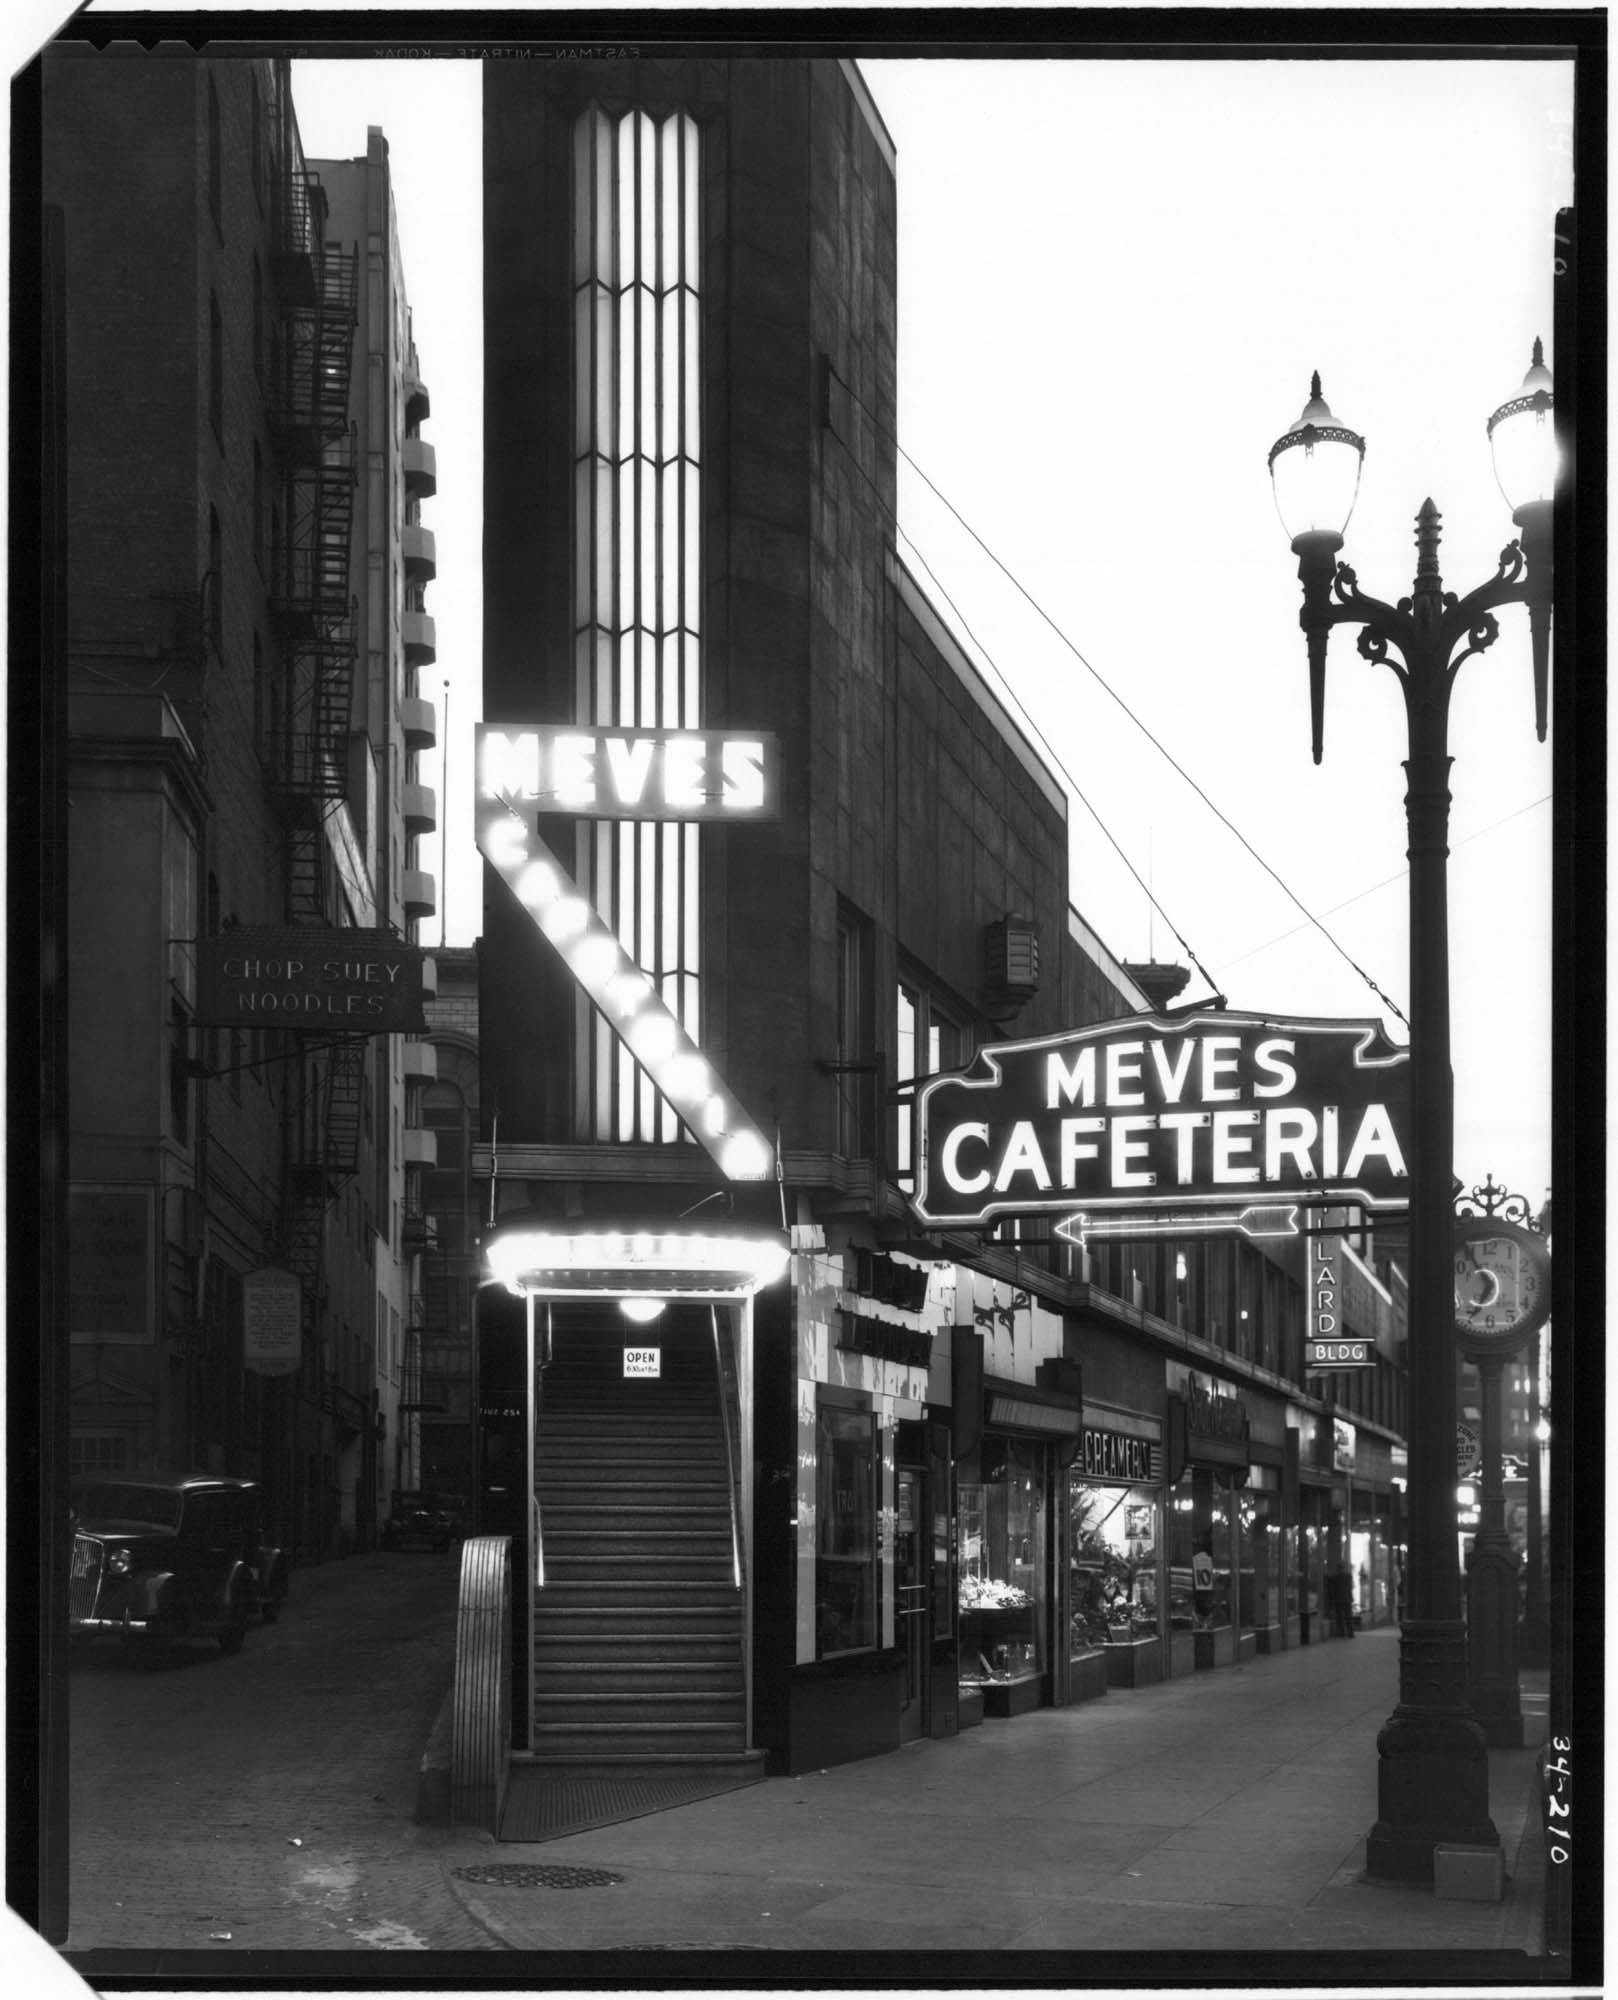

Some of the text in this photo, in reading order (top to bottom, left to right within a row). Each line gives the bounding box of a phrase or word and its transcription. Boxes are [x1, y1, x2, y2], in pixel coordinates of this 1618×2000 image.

[482, 731, 765, 808] MEVES
[223, 959, 401, 984] CHOP SUEY
[238, 992, 386, 1015] NOODLES
[1046, 1036, 1299, 1110] MEVES
[941, 1103, 1410, 1195] CAFETERIA
[626, 1352, 655, 1363] OPEN
[1315, 1345, 1364, 1360] BLDG
[1547, 1738, 1571, 1863] 34-210
